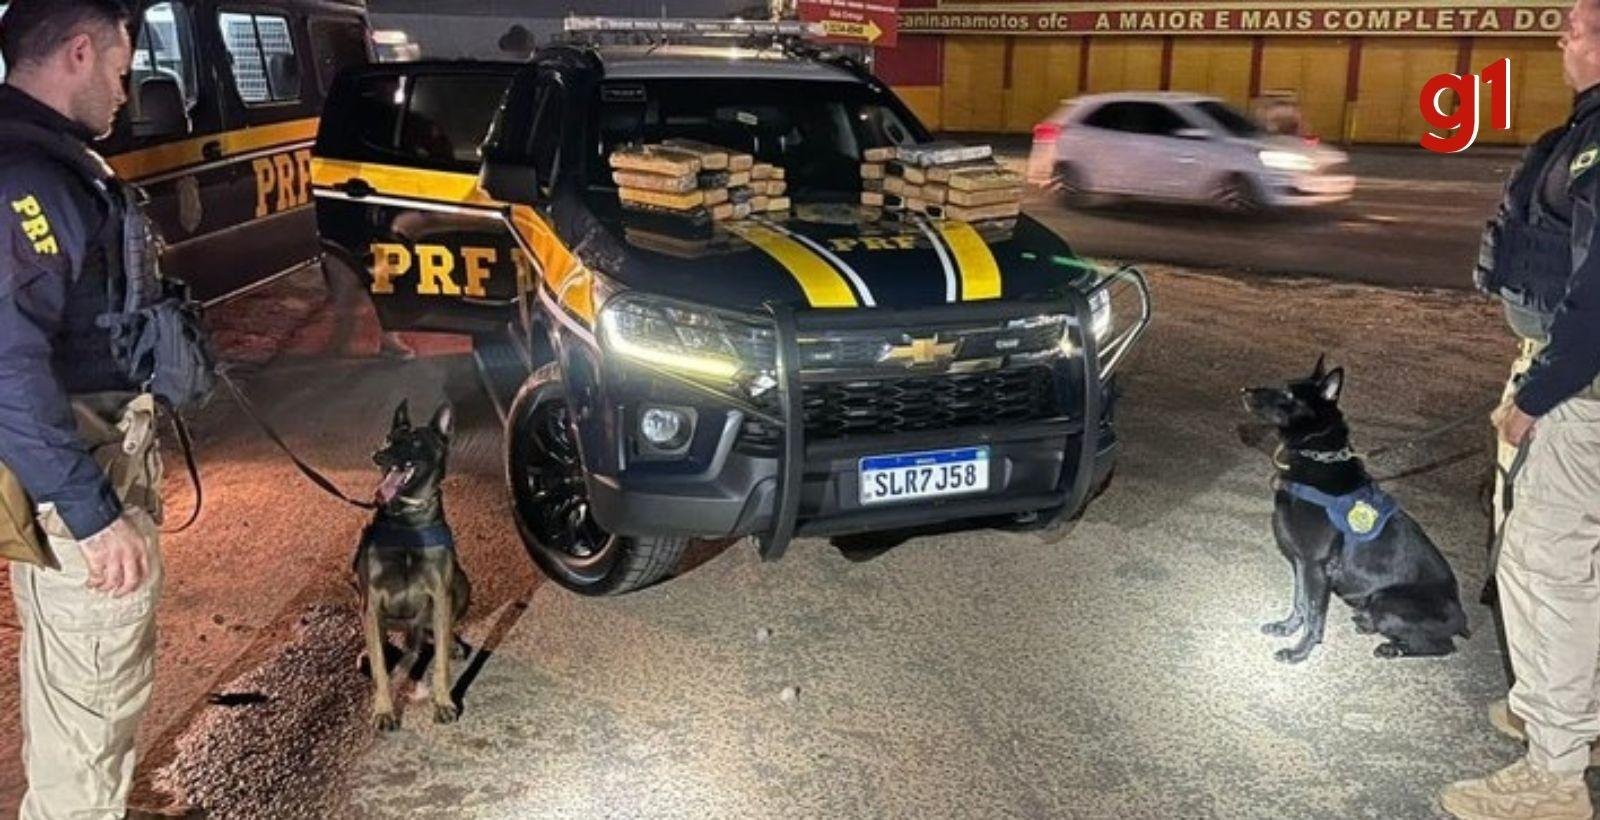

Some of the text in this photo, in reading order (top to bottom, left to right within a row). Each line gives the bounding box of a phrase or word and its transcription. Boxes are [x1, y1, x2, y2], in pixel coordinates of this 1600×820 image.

[1038, 13, 1068, 29] ofc
[1095, 9, 1563, 30] A MAIOR E MAIS COMPLETA DO
[252, 148, 312, 218] PRF
[11, 194, 58, 255] PRF
[369, 242, 496, 297] PRF
[874, 463, 977, 498] SLR7J58
